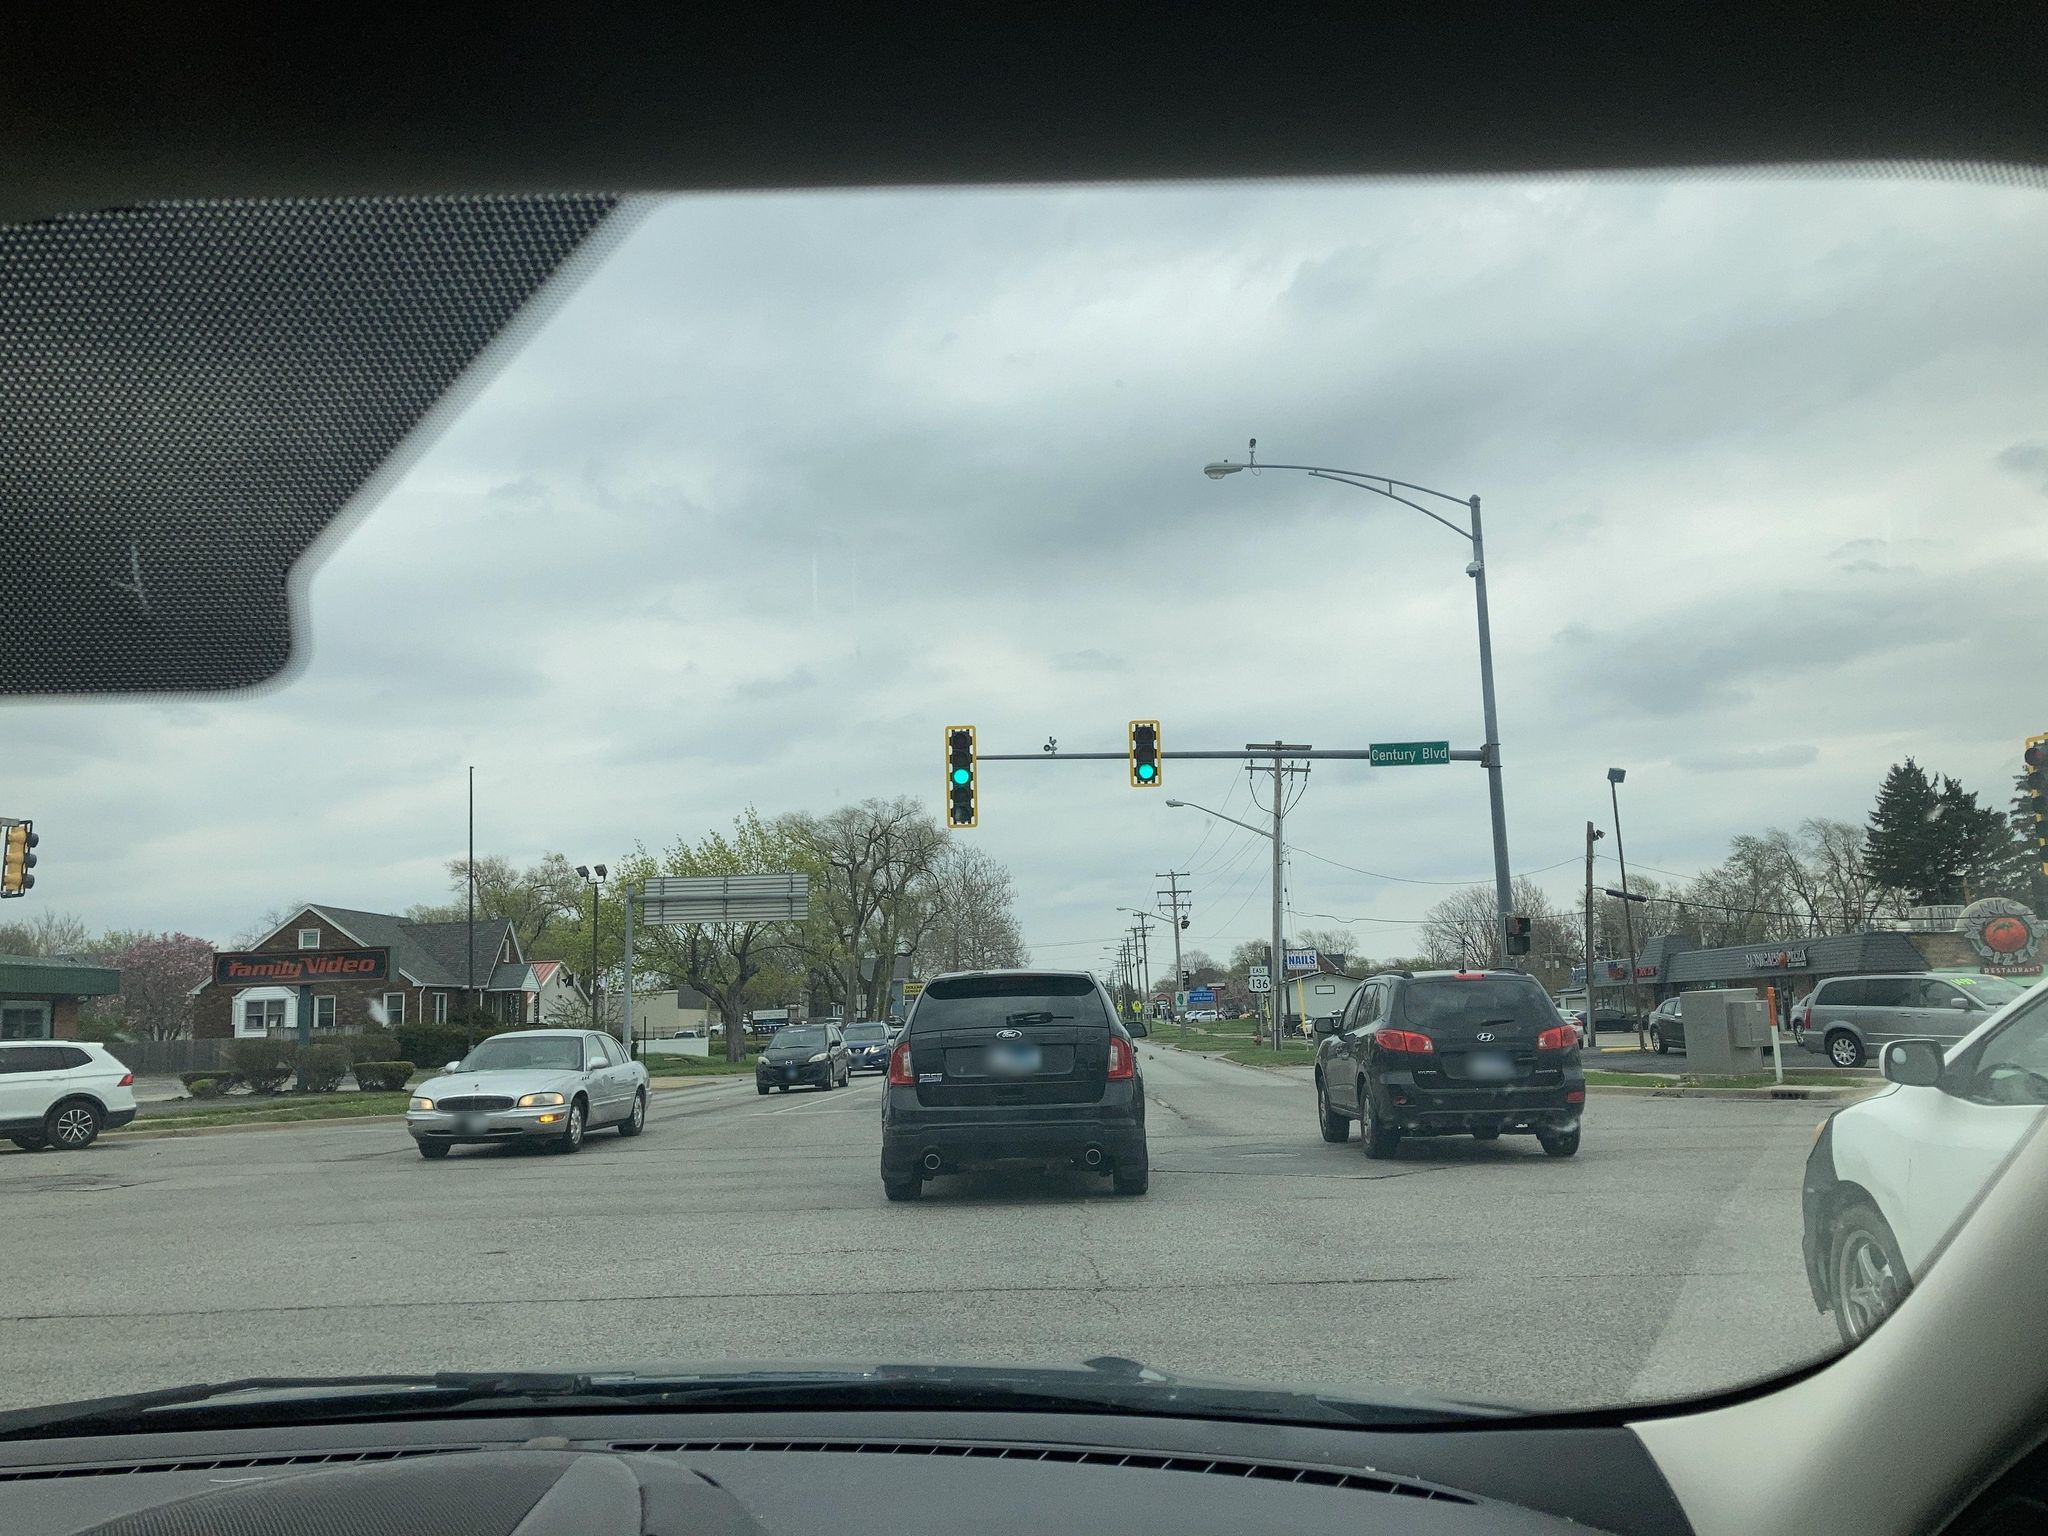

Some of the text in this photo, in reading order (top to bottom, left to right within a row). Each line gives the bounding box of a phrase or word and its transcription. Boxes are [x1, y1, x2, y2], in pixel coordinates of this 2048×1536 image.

[1371, 747, 1447, 763] Century Blvd
[1288, 955, 1316, 965] NAILS
[301, 956, 377, 975] Video
[1984, 966, 2041, 975] RESTAURANT
[1252, 979, 1268, 989] 136
